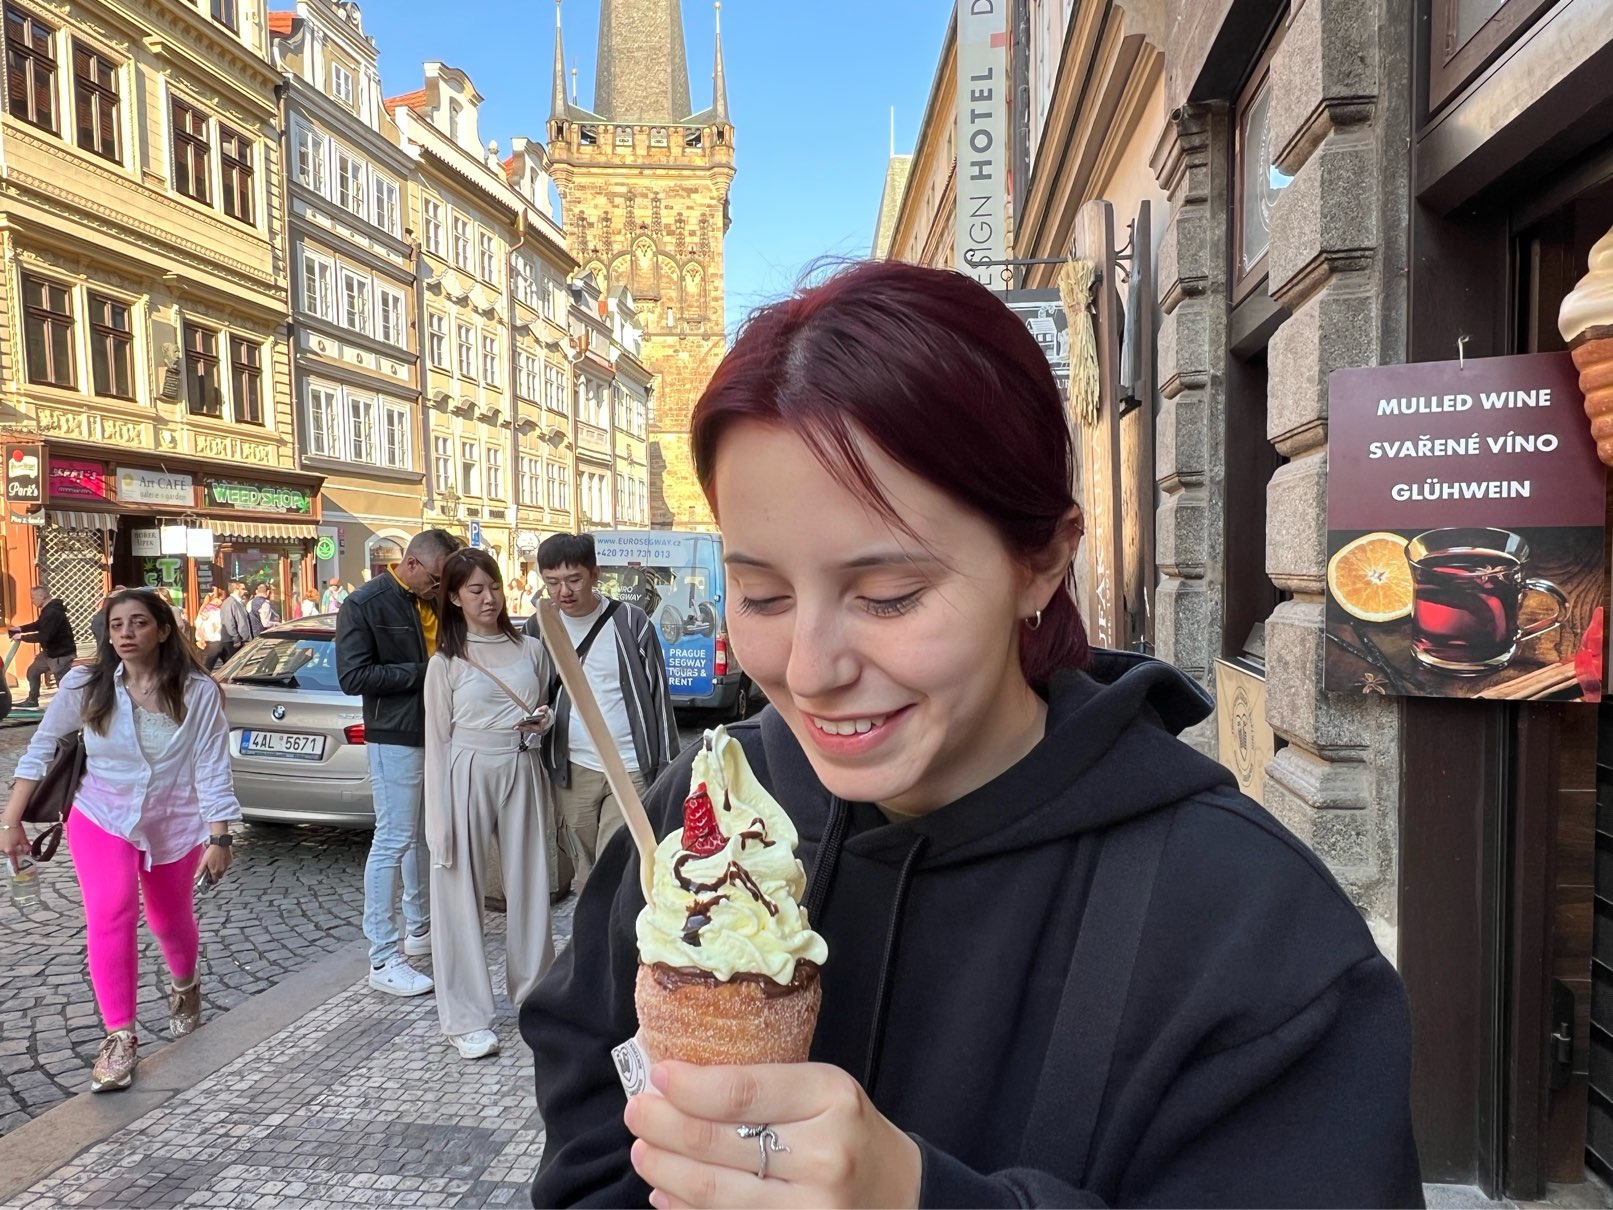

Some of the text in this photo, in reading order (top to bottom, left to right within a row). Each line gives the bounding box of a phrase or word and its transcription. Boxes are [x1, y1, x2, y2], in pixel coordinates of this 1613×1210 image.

[969, 67, 993, 286] ESIGN HOTEL
[1377, 389, 1551, 416] MULLED WINE
[1369, 431, 1559, 459] SVAŘENÉ VÍNO
[8, 482, 38, 497] Park's
[140, 475, 187, 491] Art CAFÉ
[1391, 478, 1531, 501] GLÜHWEIN
[212, 483, 261, 505] WEED
[261, 488, 304, 509] SHOP
[472, 523, 479, 539] P
[619, 549, 634, 557] 731
[637, 550, 652, 558] 731
[654, 550, 671, 558] 013
[669, 648, 706, 658] PRAGUE
[669, 658, 706, 667] SEGWAY
[669, 667, 707, 677] TOURS &
[669, 677, 693, 686] RENT
[252, 733, 275, 749] 4AL
[285, 736, 317, 753] 5671
